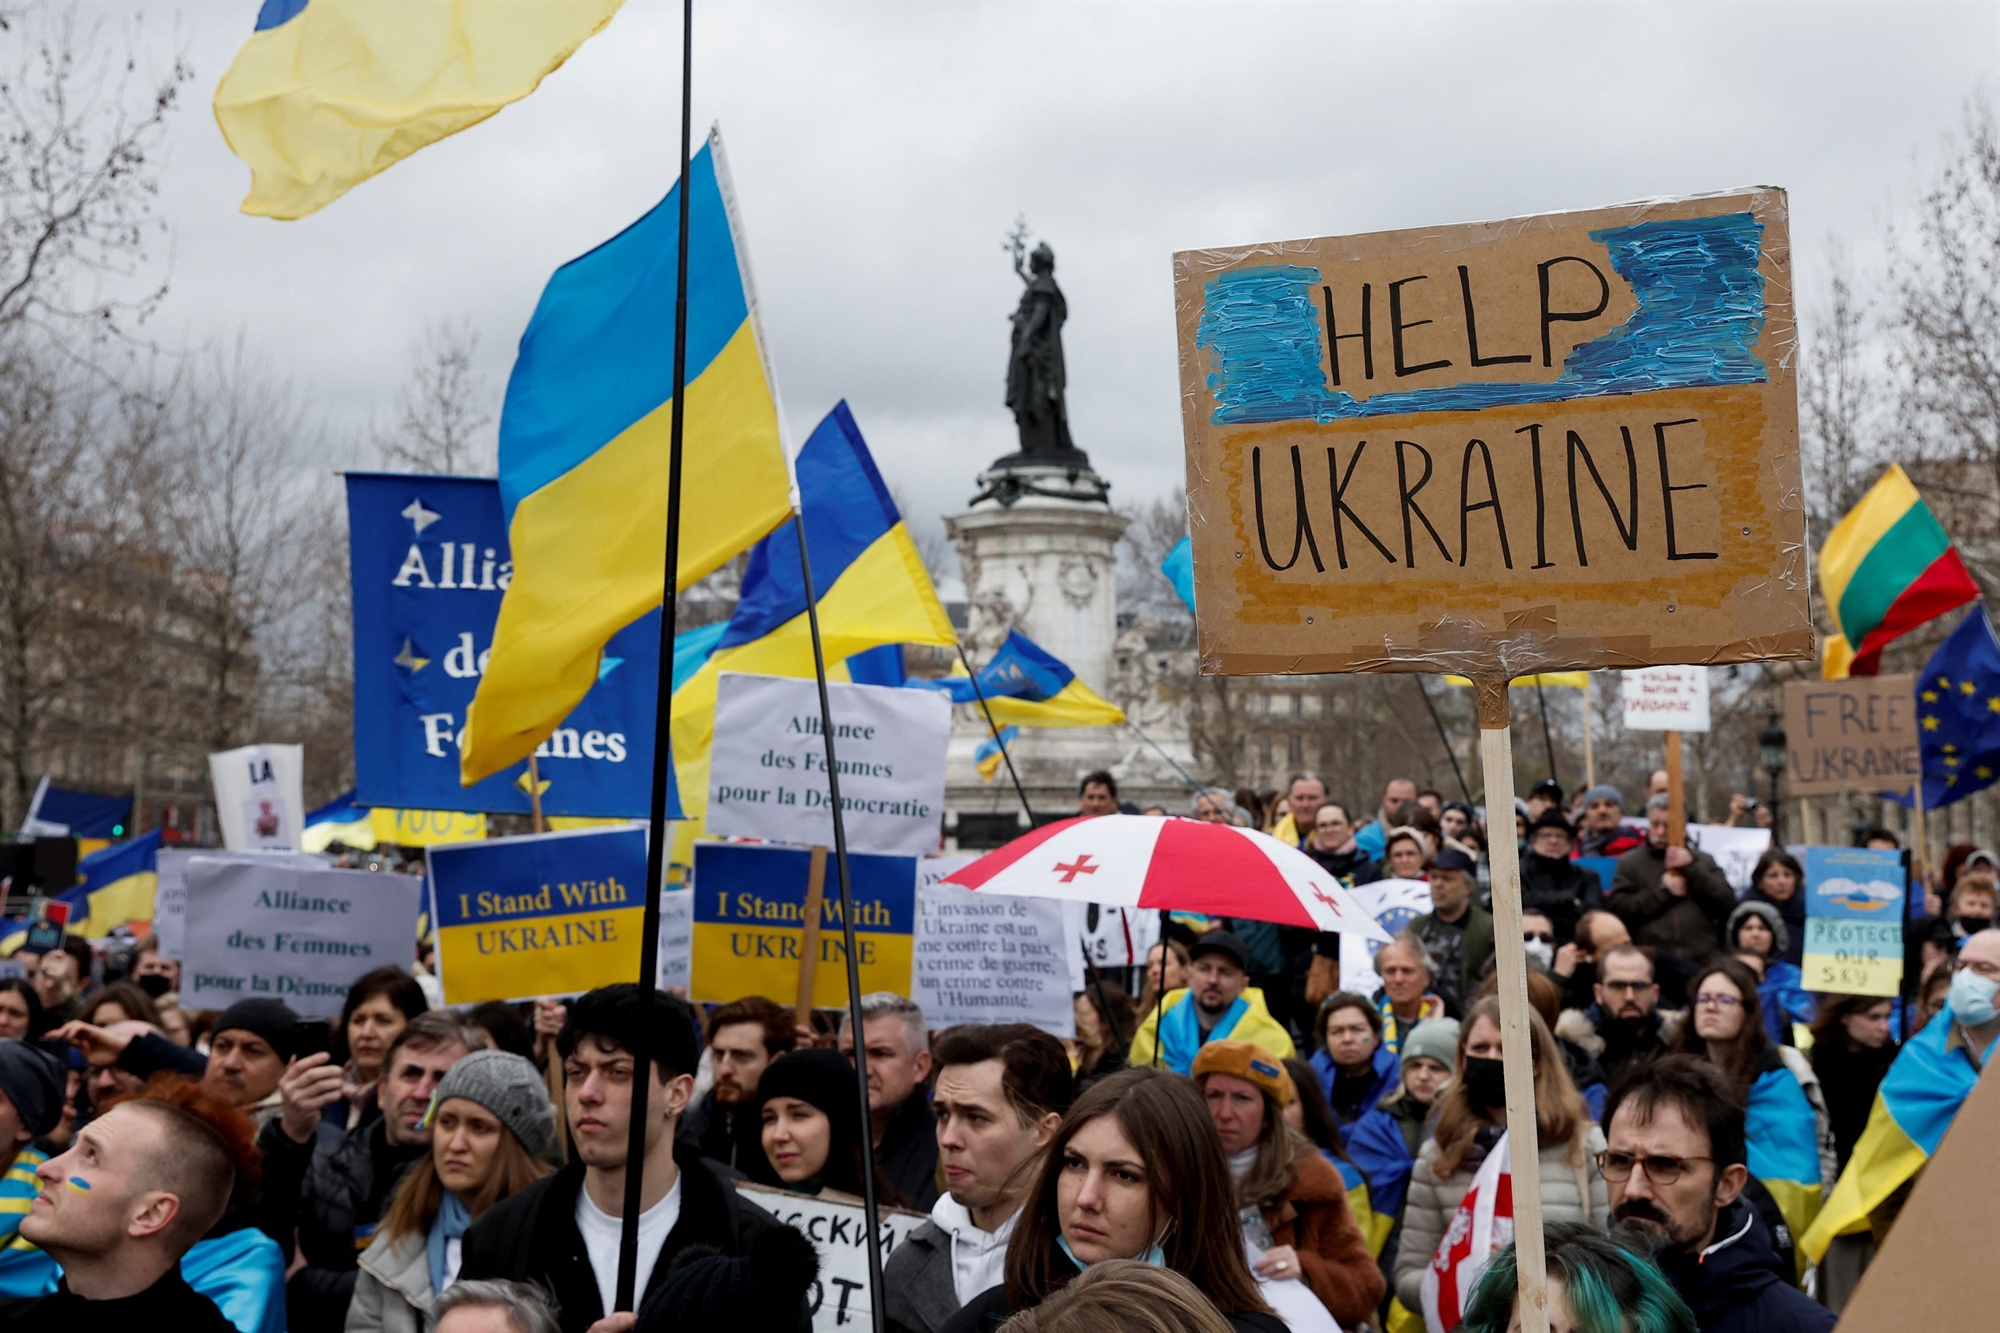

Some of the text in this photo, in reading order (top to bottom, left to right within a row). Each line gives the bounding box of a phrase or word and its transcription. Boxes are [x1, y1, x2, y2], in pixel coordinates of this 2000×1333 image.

[1322, 256, 1610, 386] HELP
[1253, 419, 1719, 573] UKRAINE
[392, 541, 514, 591] Allia
[1804, 691, 1907, 739] FREE
[419, 713, 627, 763] Fmes
[761, 749, 796, 769] des
[1791, 744, 1920, 783] UKRAINE
[248, 760, 275, 784] LA
[717, 785, 771, 804] pour
[778, 786, 796, 805] la
[255, 889, 352, 914] Alliance
[459, 877, 628, 918] I Stand With
[716, 891, 729, 917] I
[1009, 901, 1028, 917] de
[476, 918, 618, 955] UKRAINE
[993, 922, 1015, 935] est
[1019, 924, 1038, 936] un
[1813, 922, 1903, 944] PROTECT
[226, 930, 373, 958] des Femmes
[730, 932, 877, 965] UKRINE
[946, 938, 998, 953] contre
[1001, 937, 1016, 952] la
[927, 956, 974, 971] crime
[979, 956, 998, 971] de
[1834, 947, 1880, 967] OUR
[193, 973, 247, 993] pour
[251, 974, 271, 993] la
[920, 973, 1044, 991] un crime contre
